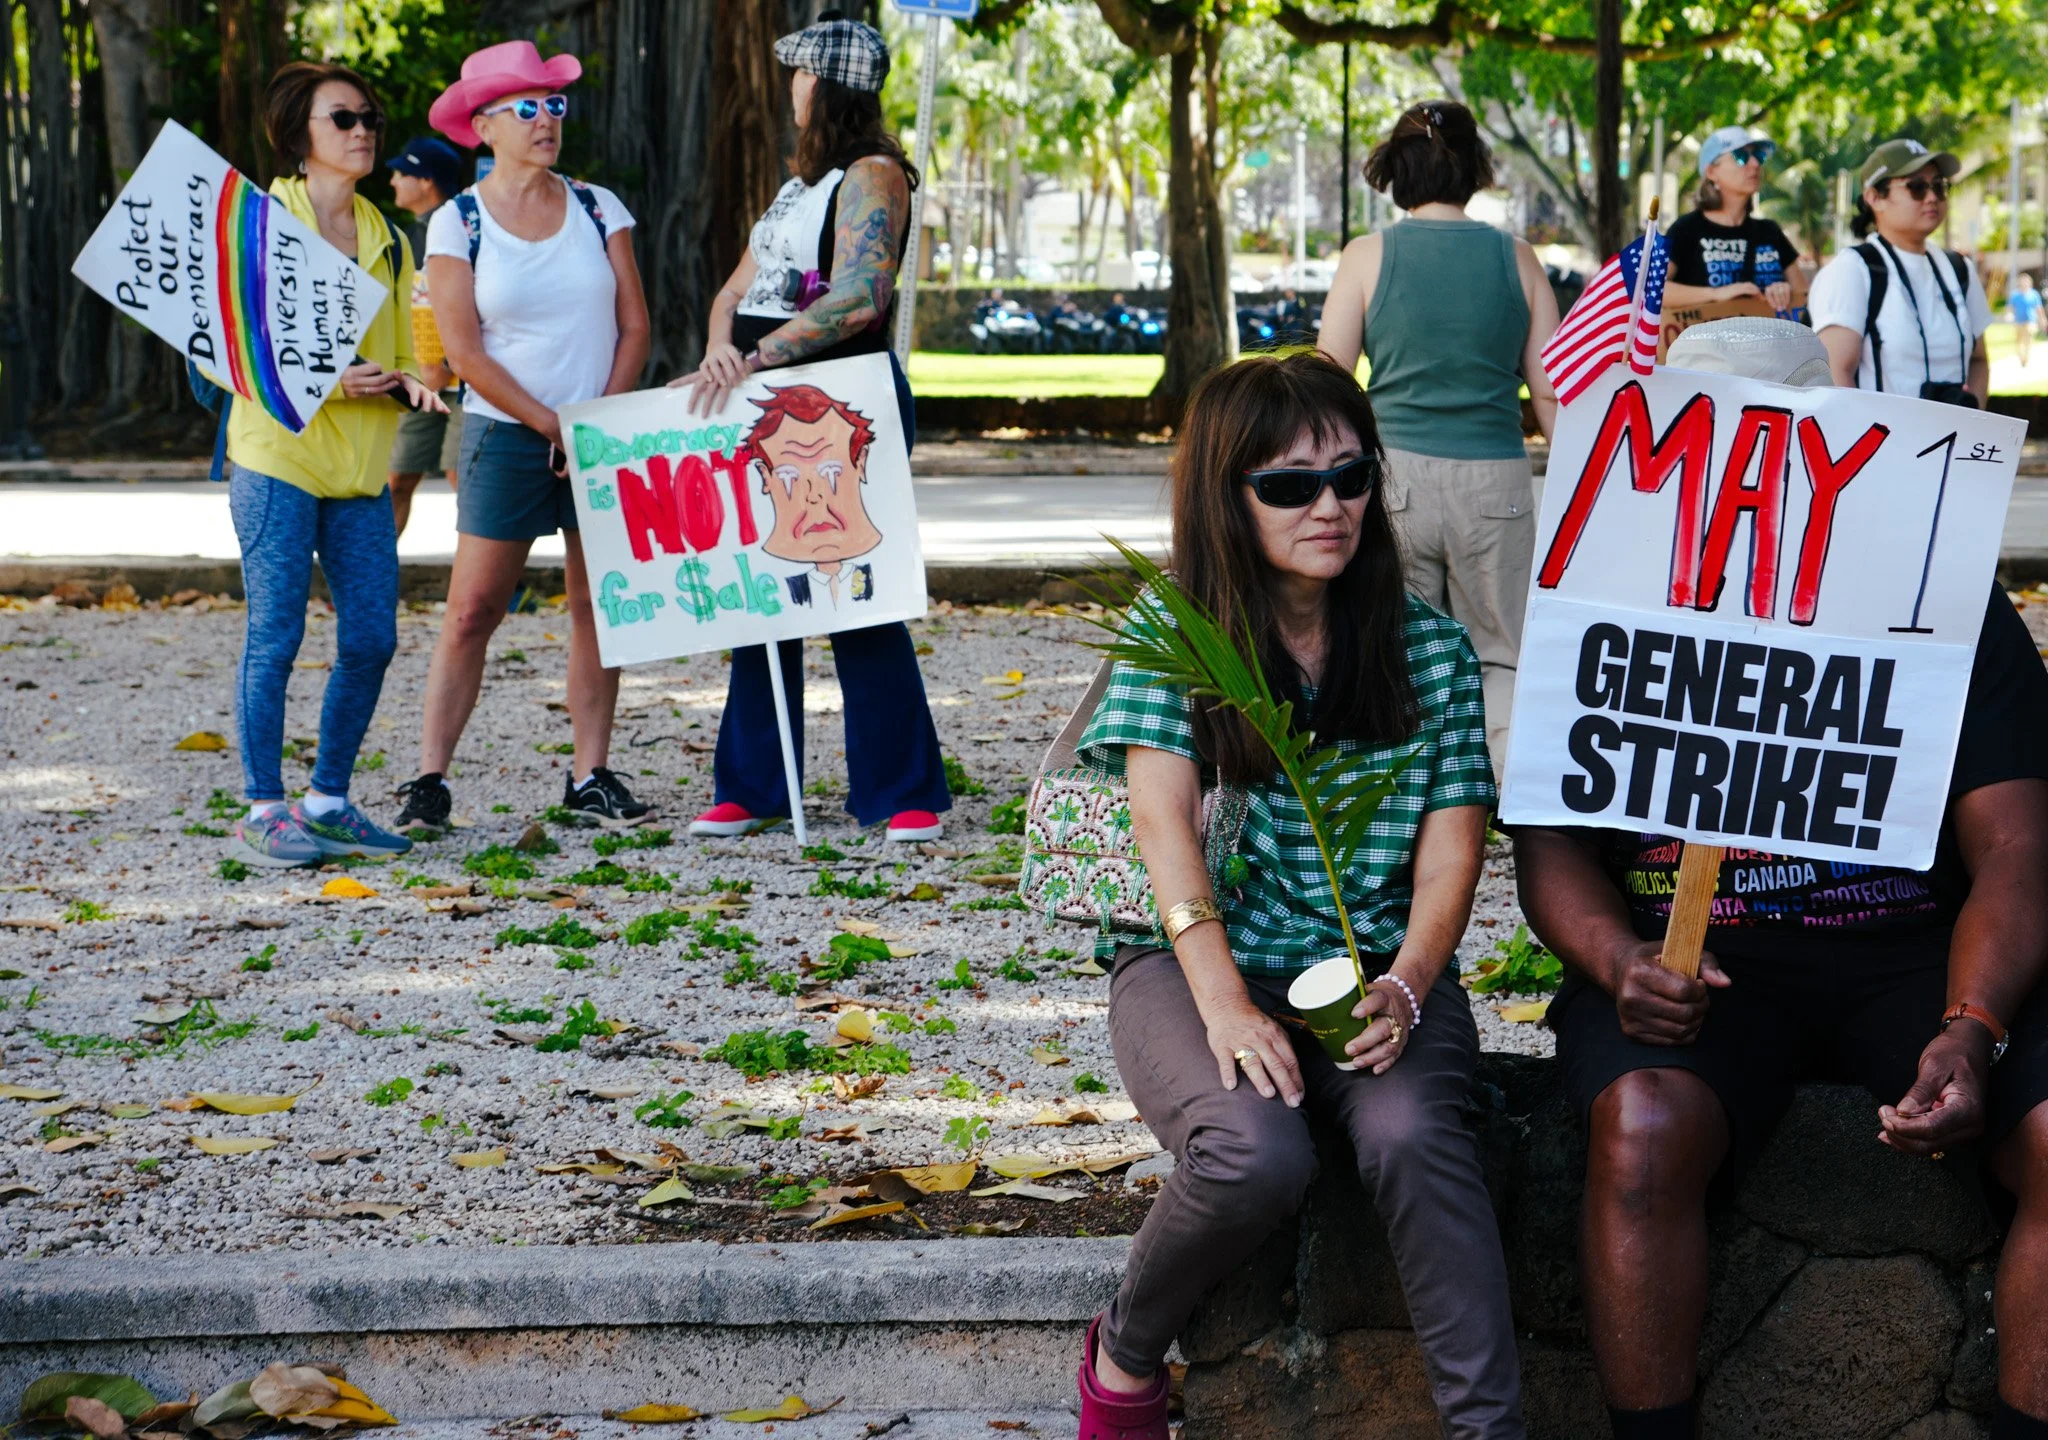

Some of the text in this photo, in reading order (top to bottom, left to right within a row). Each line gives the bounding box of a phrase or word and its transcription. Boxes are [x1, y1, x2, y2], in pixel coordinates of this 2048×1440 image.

[116, 192, 152, 311] Protect
[159, 219, 179, 295] our
[187, 174, 216, 368] Democracy
[273, 230, 308, 372] Diversity
[1700, 238, 1747, 252] VOTE
[306, 278, 337, 398] & Human
[333, 265, 361, 349] Rights
[1672, 310, 1702, 321] THE
[586, 446, 759, 562] is NOT
[1537, 380, 1891, 627] MAY
[599, 552, 784, 627] for $ale
[1575, 622, 1904, 748] GENERAL
[1561, 714, 1898, 851] STRIKE!
[1734, 862, 1817, 894] CANADA
[1810, 875, 1930, 909] PROTECTIONS
